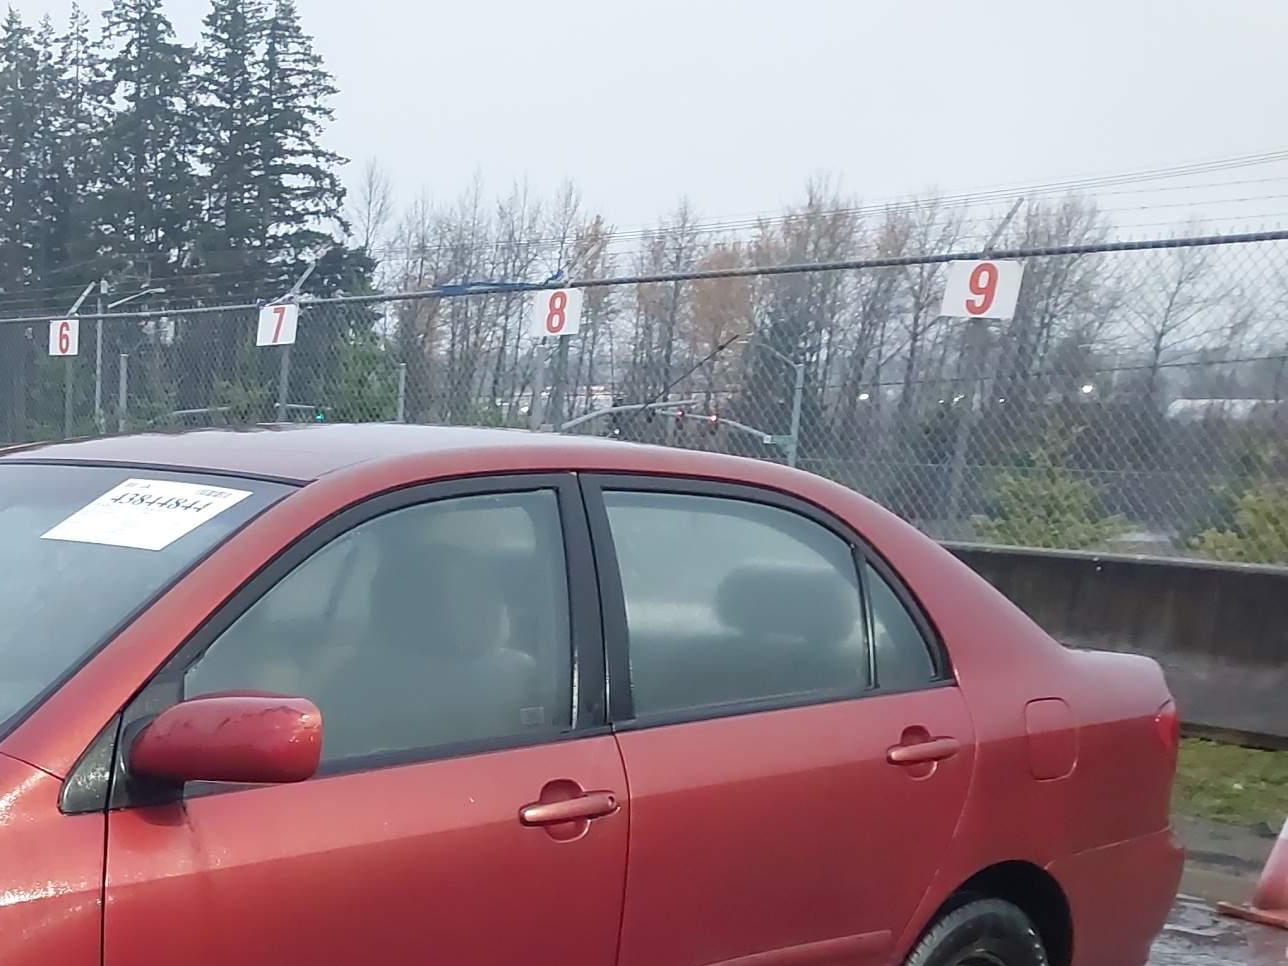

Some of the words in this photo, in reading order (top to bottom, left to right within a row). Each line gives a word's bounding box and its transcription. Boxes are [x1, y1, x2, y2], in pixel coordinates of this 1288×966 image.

[964, 262, 999, 316] 9
[272, 305, 286, 343] 7
[545, 290, 568, 335] 8
[59, 321, 70, 354] 6
